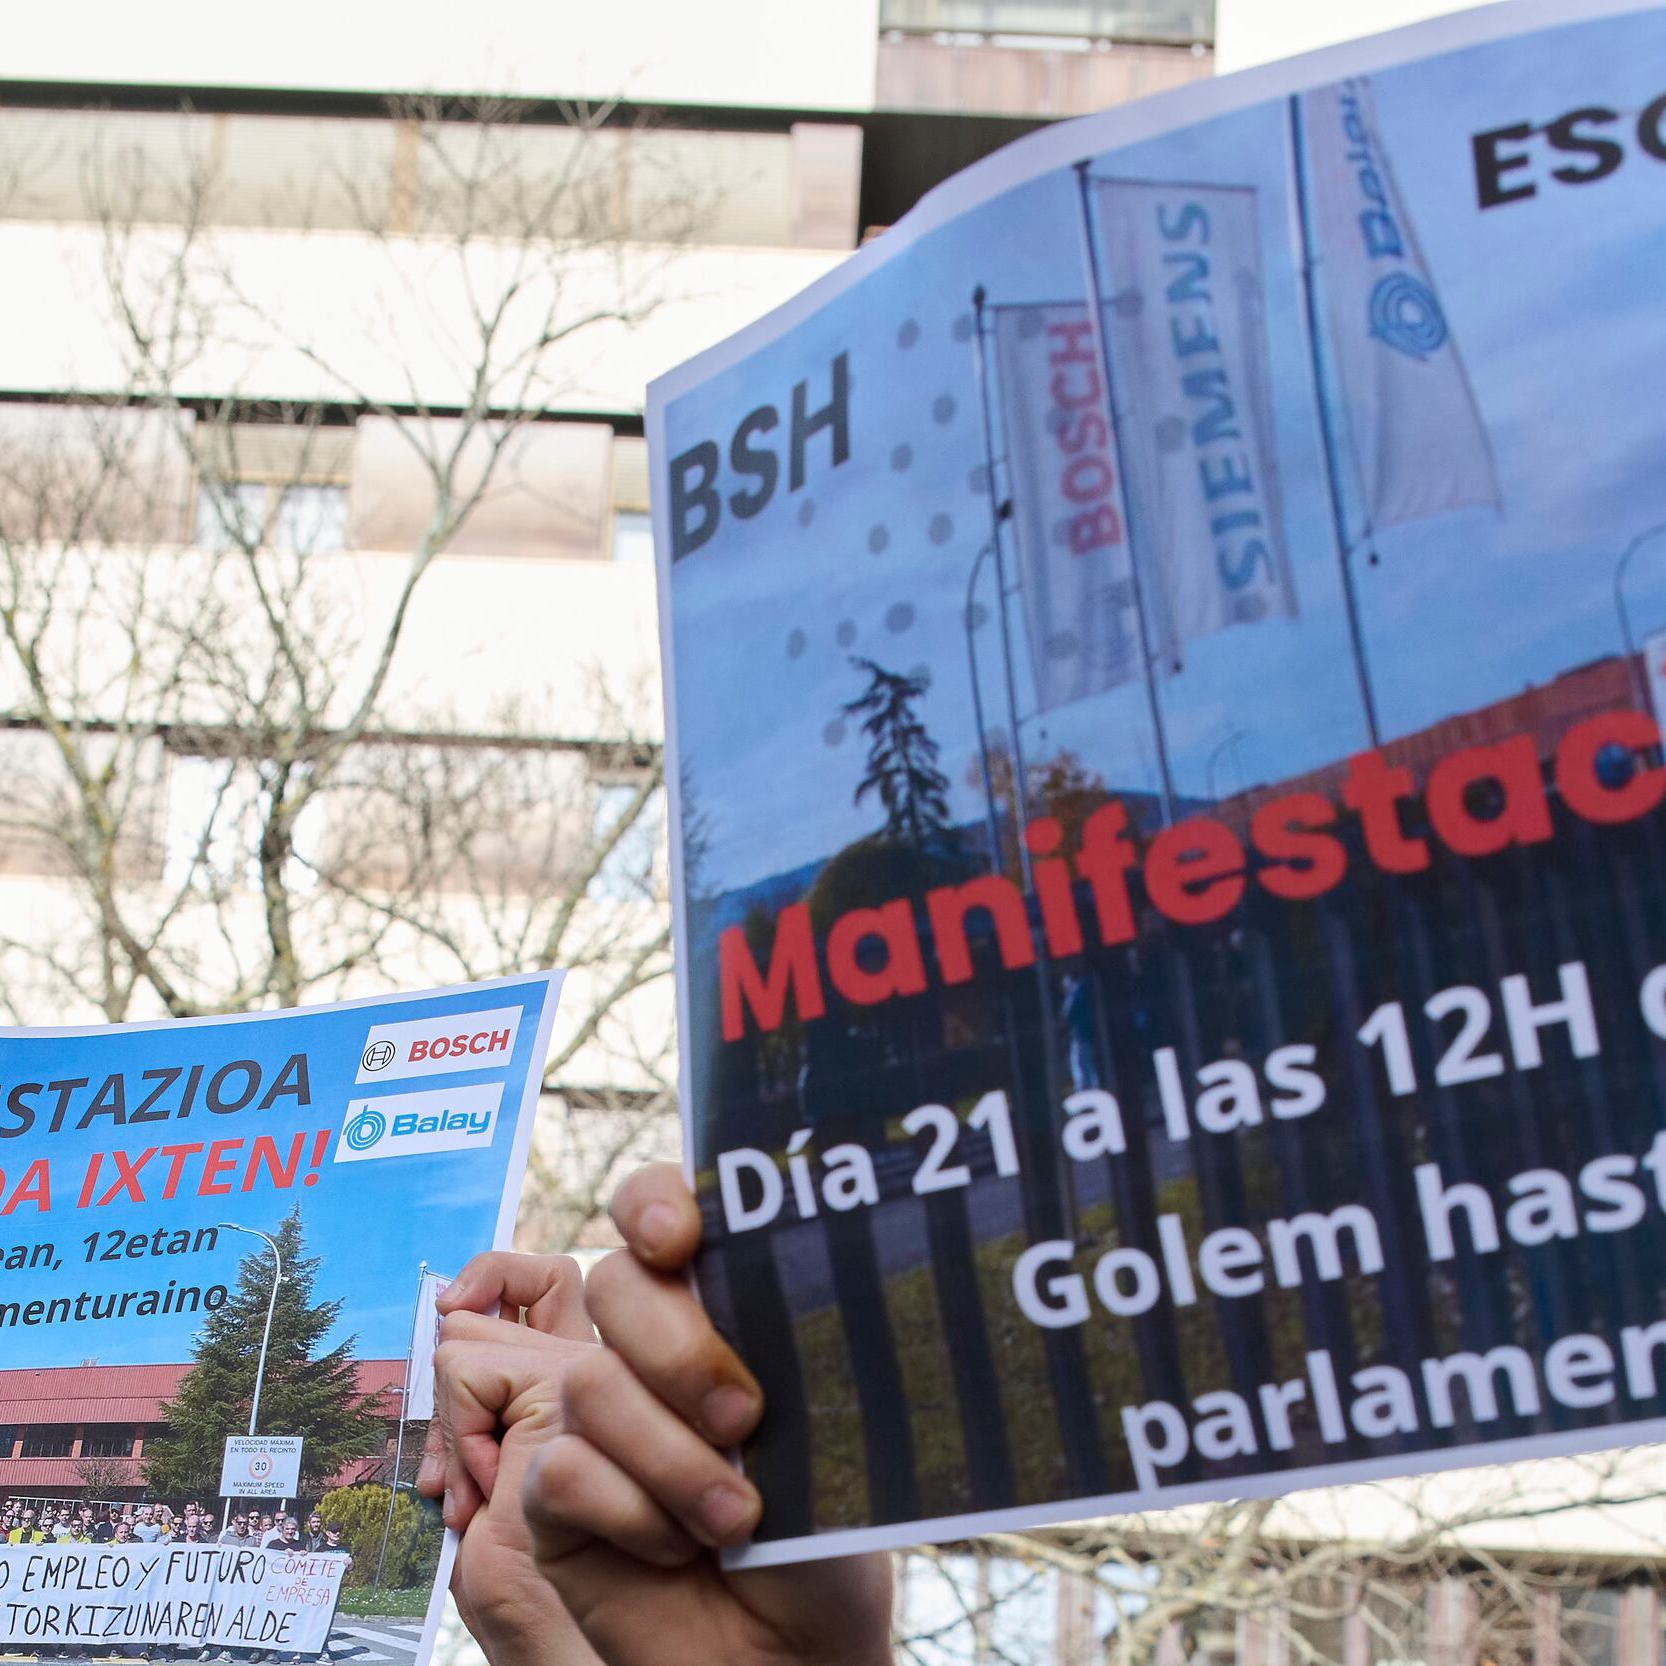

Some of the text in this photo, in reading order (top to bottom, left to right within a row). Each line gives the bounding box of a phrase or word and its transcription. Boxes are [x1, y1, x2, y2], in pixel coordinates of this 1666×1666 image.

[669, 351, 852, 566] BSH
[1046, 318, 1123, 558] BOSCH
[406, 1029, 512, 1063] BOSCH
[717, 1129, 880, 1234] Día
[901, 1089, 1022, 1196] 21
[1060, 1089, 1127, 1162] a
[1153, 1042, 1327, 1142] las
[1357, 961, 1600, 1097] 12H
[391, 1109, 493, 1137] Balay
[76, 1128, 332, 1209] IXTEN!
[82, 1225, 220, 1263] 12etan
[1012, 1203, 1386, 1330] Golem
[254, 1462, 267, 1471] 30
[22, 1555, 131, 1593] EMPLEO
[165, 1550, 267, 1586] FUTURO
[266, 1585, 332, 1607] EMPRESA
[228, 1606, 298, 1645] ALDE
